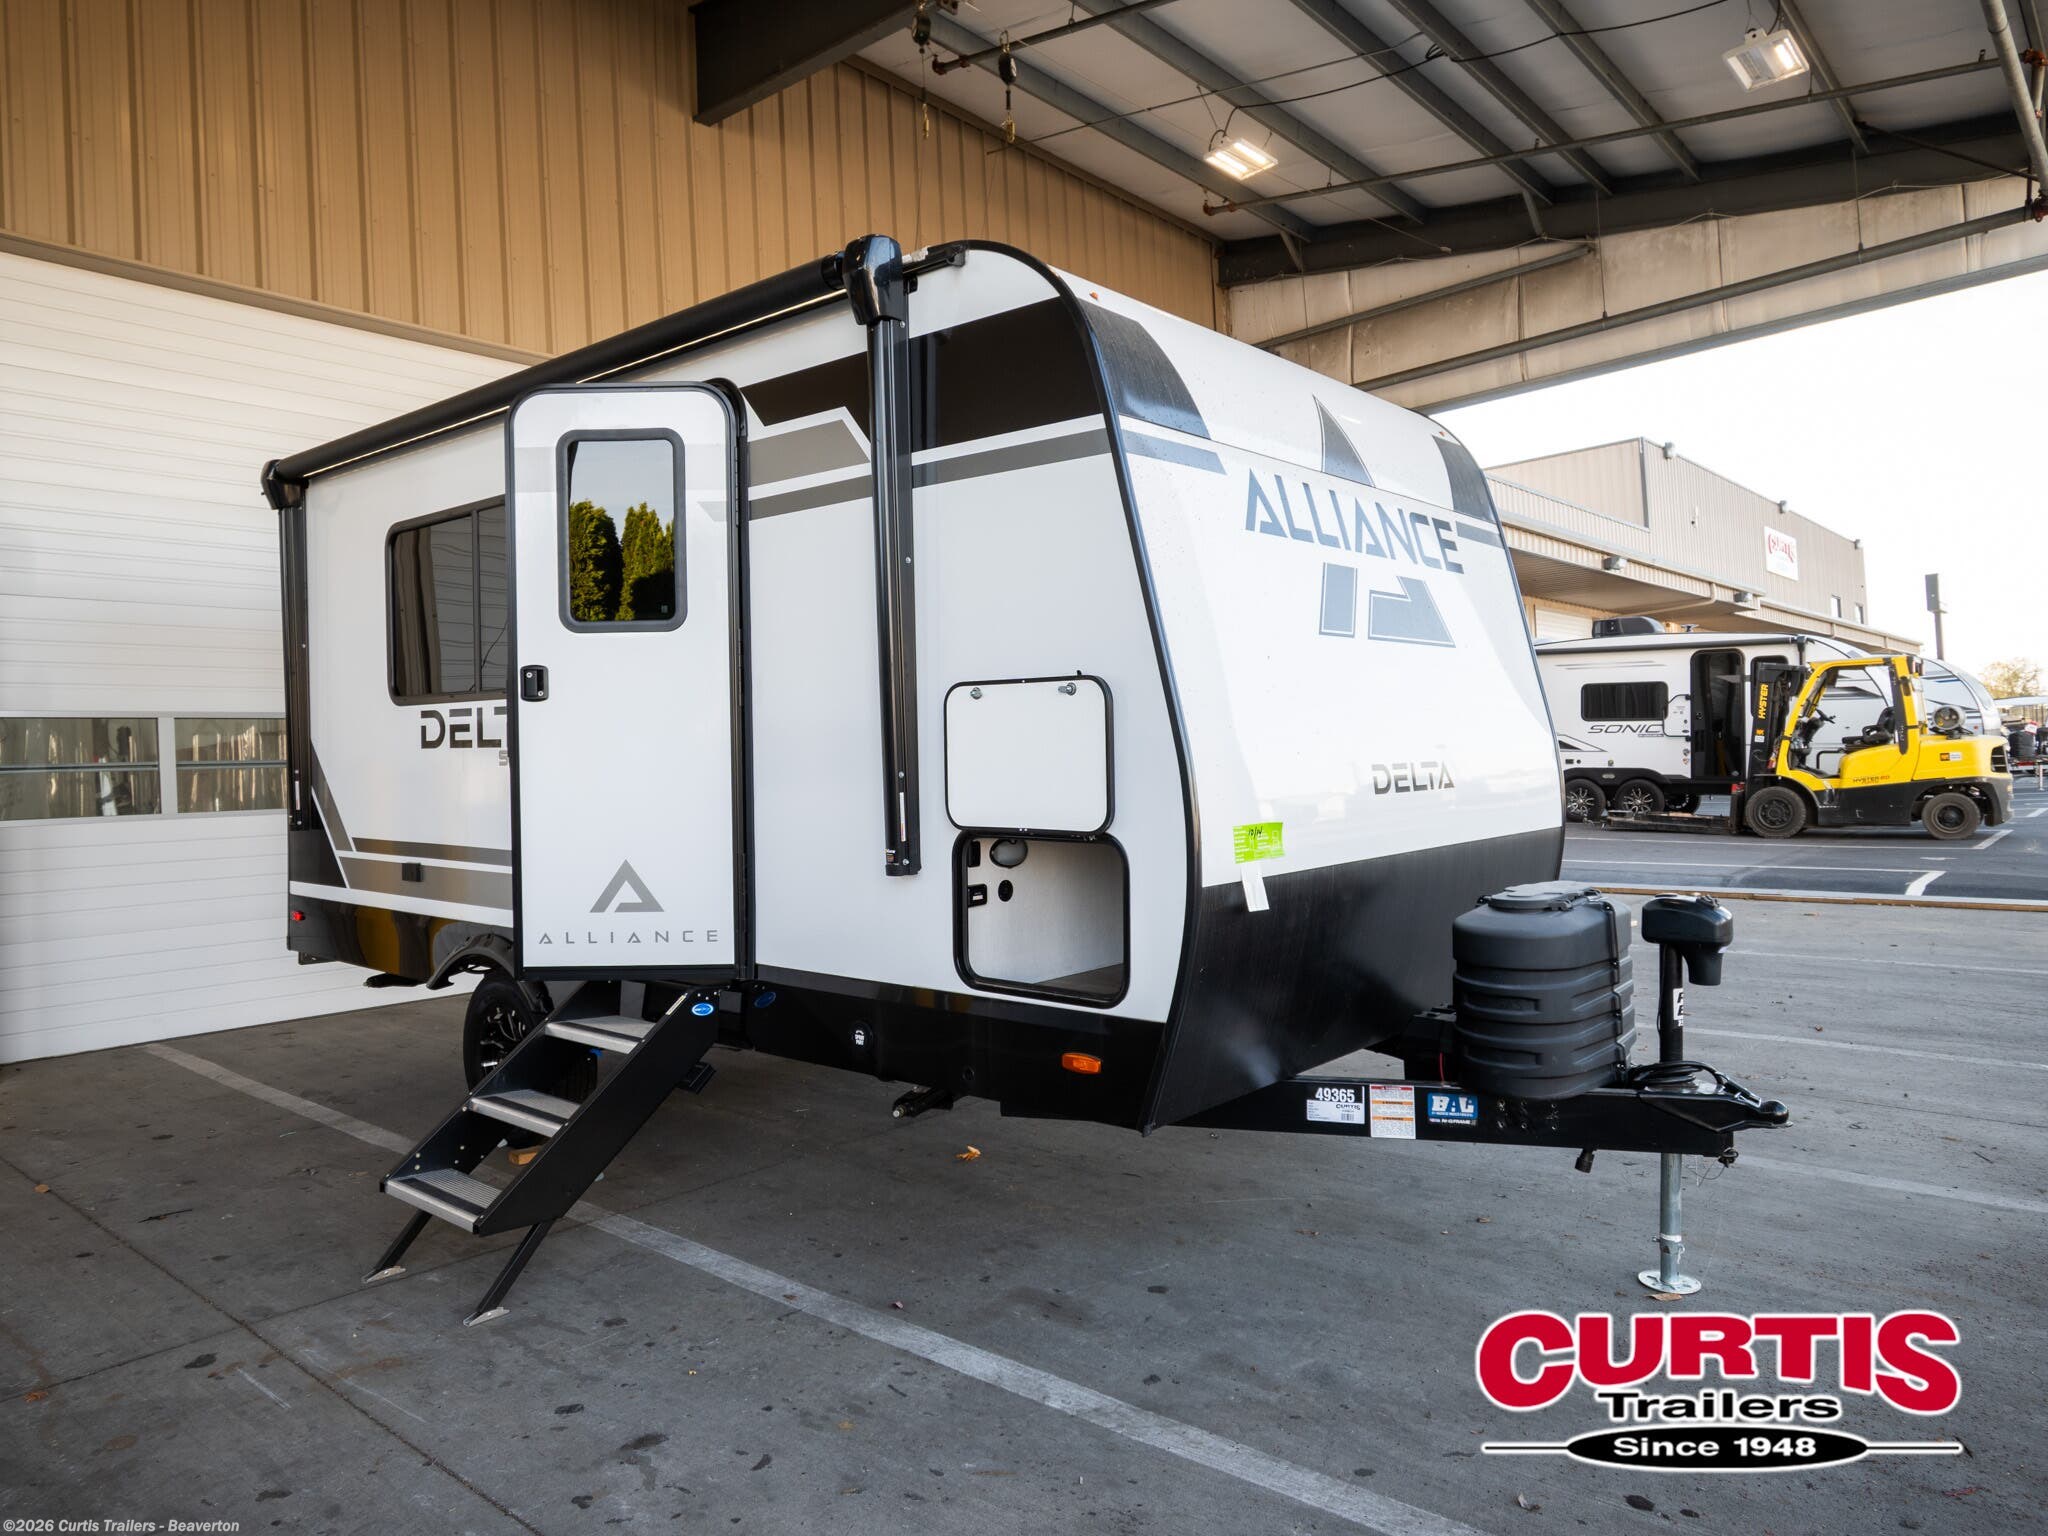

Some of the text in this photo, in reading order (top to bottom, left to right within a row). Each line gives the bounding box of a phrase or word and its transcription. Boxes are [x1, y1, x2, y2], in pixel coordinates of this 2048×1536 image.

[1245, 468, 1464, 574] ALLIANCE
[1758, 683, 1769, 720] HYSTER
[421, 706, 508, 750] DEL
[1587, 723, 1664, 734] SONIC
[1371, 761, 1456, 795] DELTA
[539, 929, 718, 944] ALLIANCE
[1315, 1087, 1355, 1103] 49365
